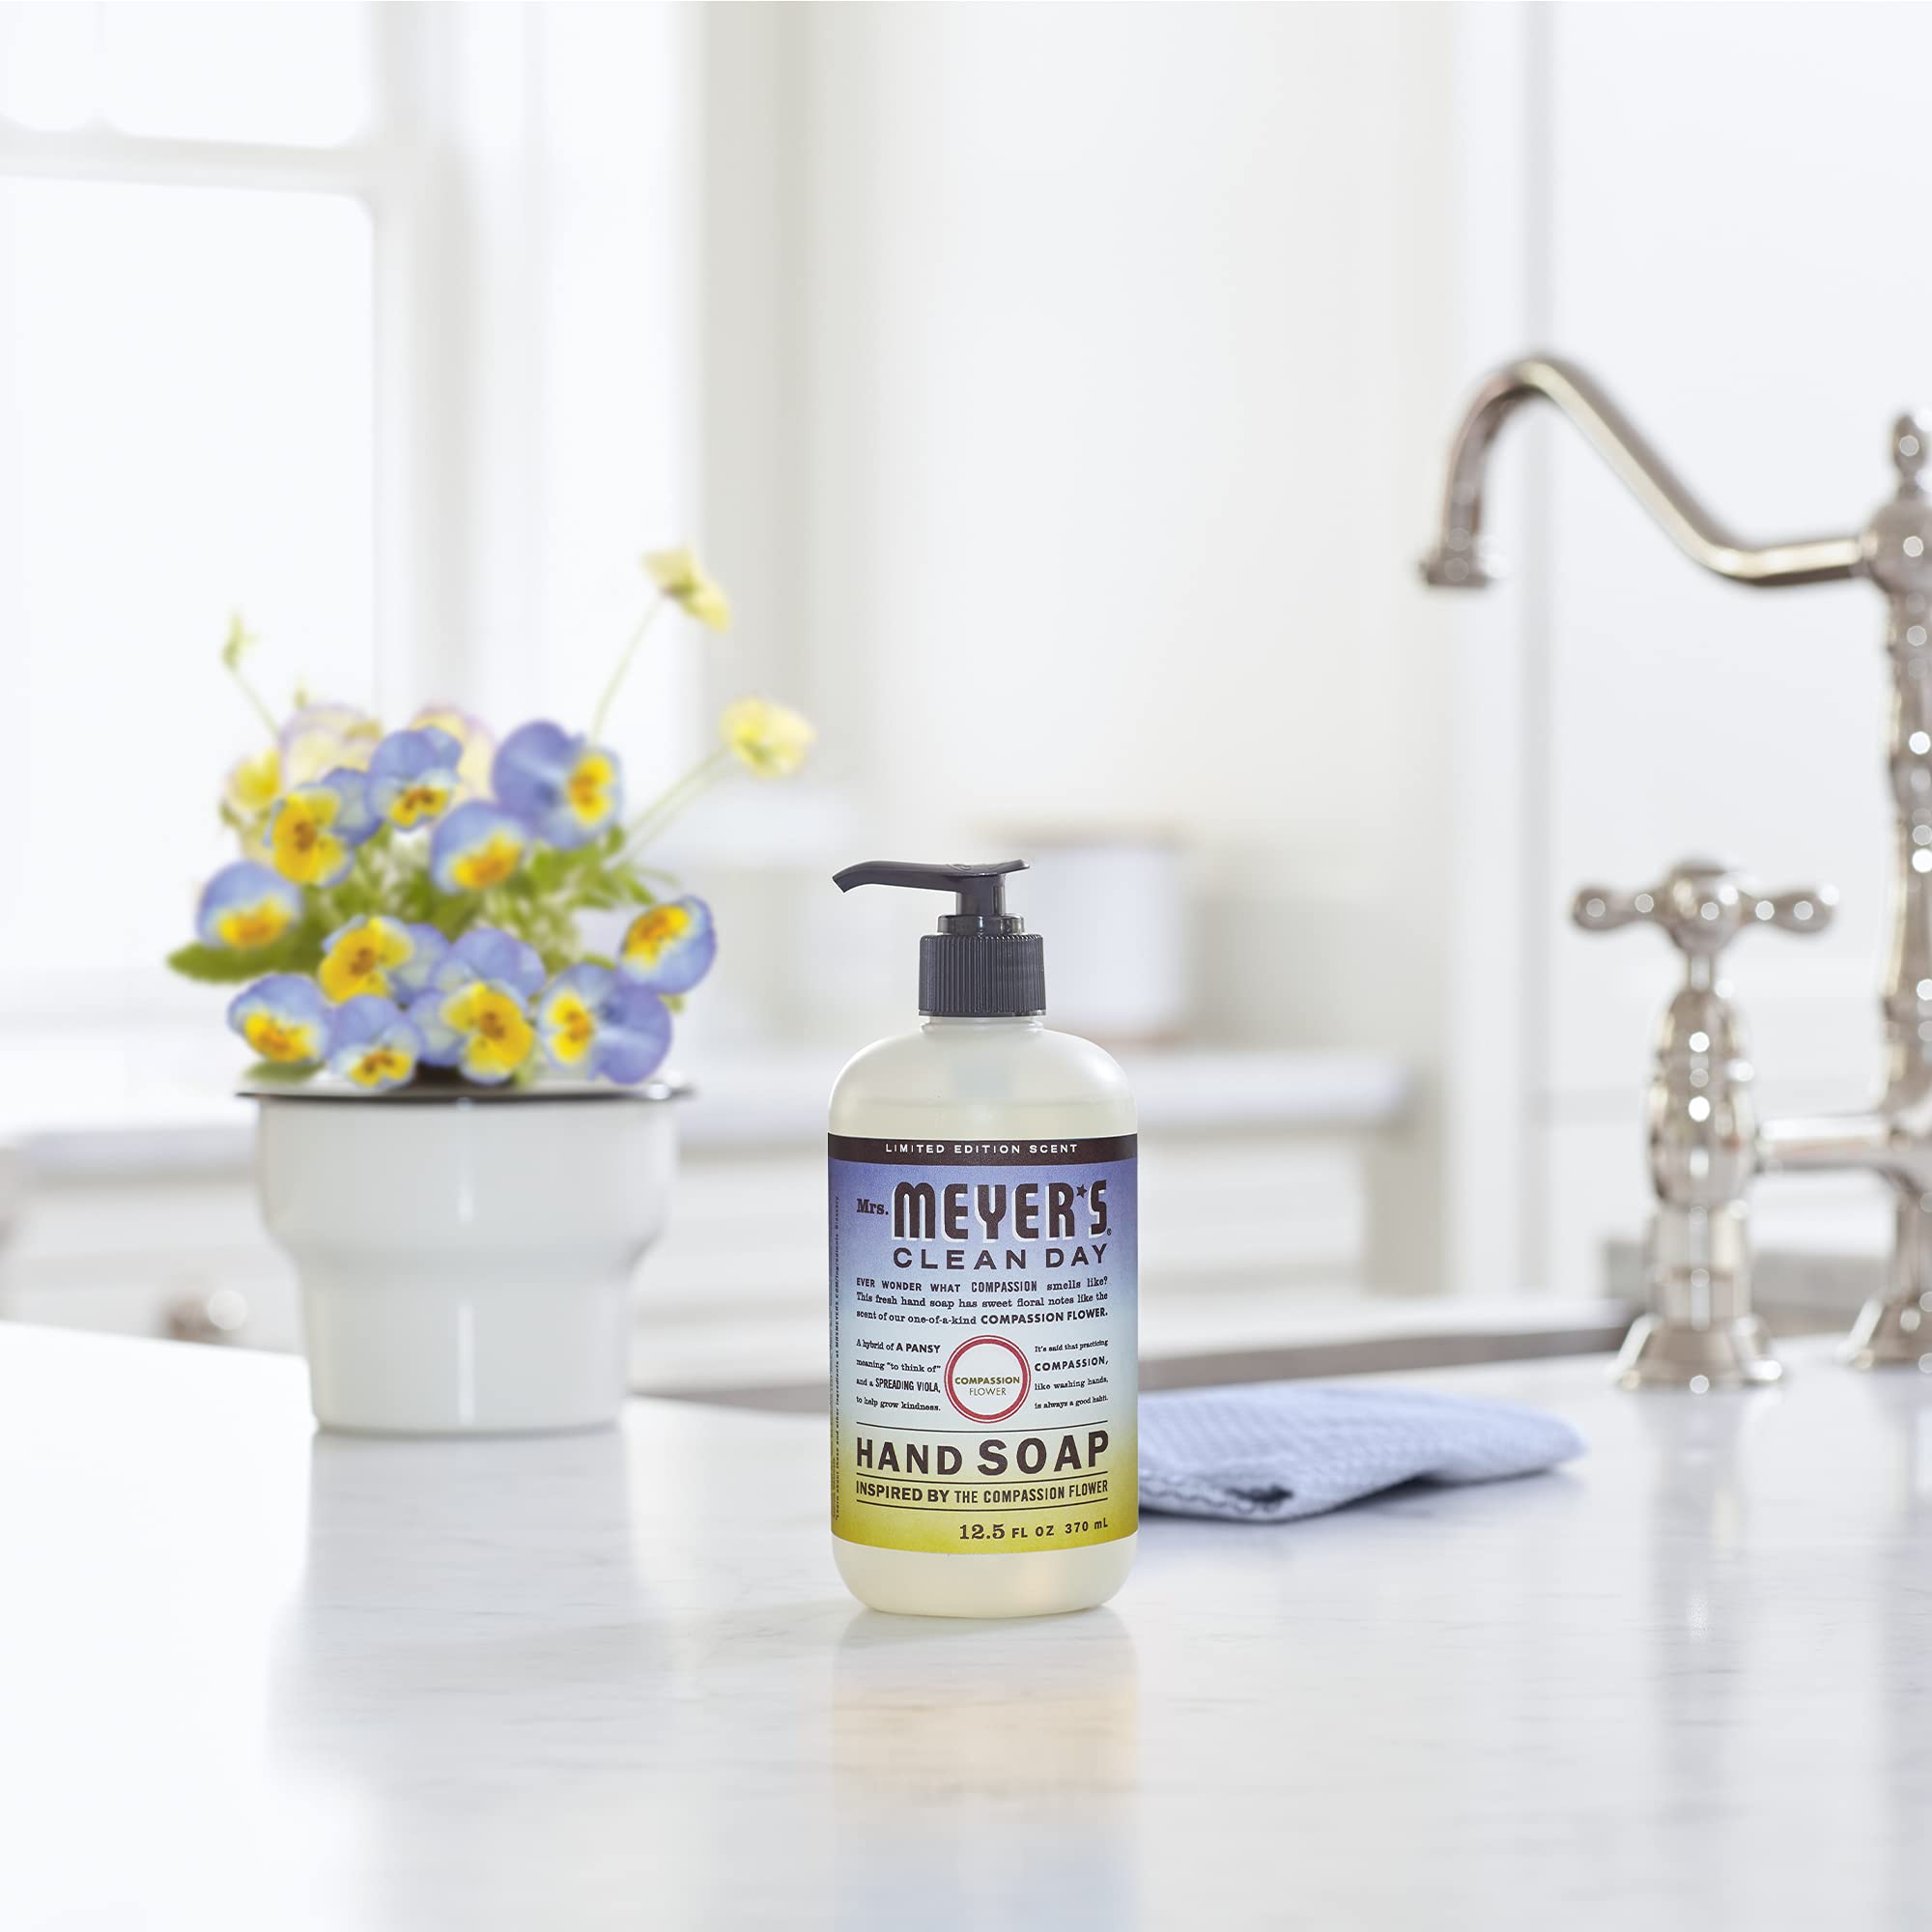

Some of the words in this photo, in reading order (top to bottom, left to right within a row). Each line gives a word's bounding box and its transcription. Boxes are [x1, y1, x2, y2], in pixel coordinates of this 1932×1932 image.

[885, 1143, 945, 1153] LIMITED
[953, 1144, 1020, 1154] EDITION
[1029, 1144, 1078, 1153] SCENT
[856, 1198, 889, 1216] Mrs.
[893, 1247, 1026, 1270] CLEAN
[1045, 1243, 1107, 1268] DAY
[856, 1277, 875, 1288] EVER
[882, 1280, 922, 1292] WONDER
[930, 1283, 960, 1293] WHAT
[971, 1281, 1037, 1293] COMPASSION
[1046, 1280, 1081, 1291] smells
[1087, 1275, 1108, 1288] like?
[856, 1292, 873, 1302] This
[875, 1294, 897, 1305] fresh
[901, 1296, 925, 1307] hand
[929, 1299, 954, 1309] soap
[958, 1298, 978, 1308] has
[981, 1299, 1012, 1308] sweet
[1017, 1297, 1044, 1307] floral
[1048, 1296, 1074, 1306] notes
[1077, 1293, 1094, 1303] like
[1096, 1292, 1108, 1301] the
[856, 1310, 877, 1320] scent
[878, 1312, 888, 1321] of
[908, 1315, 977, 1325] one-of-a-kind
[980, 1312, 1065, 1324] COMPASSION
[1066, 1307, 1108, 1321] FLOWER.
[863, 1340, 884, 1350] hybrid
[886, 1343, 895, 1351] of
[895, 1343, 903, 1351] A
[905, 1344, 941, 1353] PANSY
[1079, 1339, 1108, 1350] practicing
[856, 1359, 885, 1371] meaning
[901, 1363, 924, 1372] think
[1034, 1355, 1109, 1372] COMPASSION,
[875, 1378, 914, 1391] SPREADING
[917, 1381, 941, 1393] VIOLA,
[954, 1376, 1020, 1385] COMPASSION
[1053, 1379, 1085, 1389] washing
[1087, 1376, 1109, 1386] hands,
[969, 1387, 1007, 1396] FLOWER
[864, 1398, 878, 1407] help
[900, 1402, 941, 1411] kindness.
[1075, 1397, 1091, 1406] good
[856, 1436, 963, 1475] HAND
[977, 1430, 1108, 1476] SOAP
[856, 1480, 923, 1502] INSPIRED
[927, 1490, 950, 1503] BY
[954, 1491, 978, 1503] THE
[983, 1486, 1065, 1503] COMPASSION
[1068, 1479, 1108, 1498] FLOWER
[959, 1523, 1006, 1540] 12.5
[1011, 1527, 1028, 1539] FL
[1035, 1525, 1055, 1537] OZ
[1065, 1521, 1089, 1534] 370
[1094, 1518, 1108, 1530] mL
